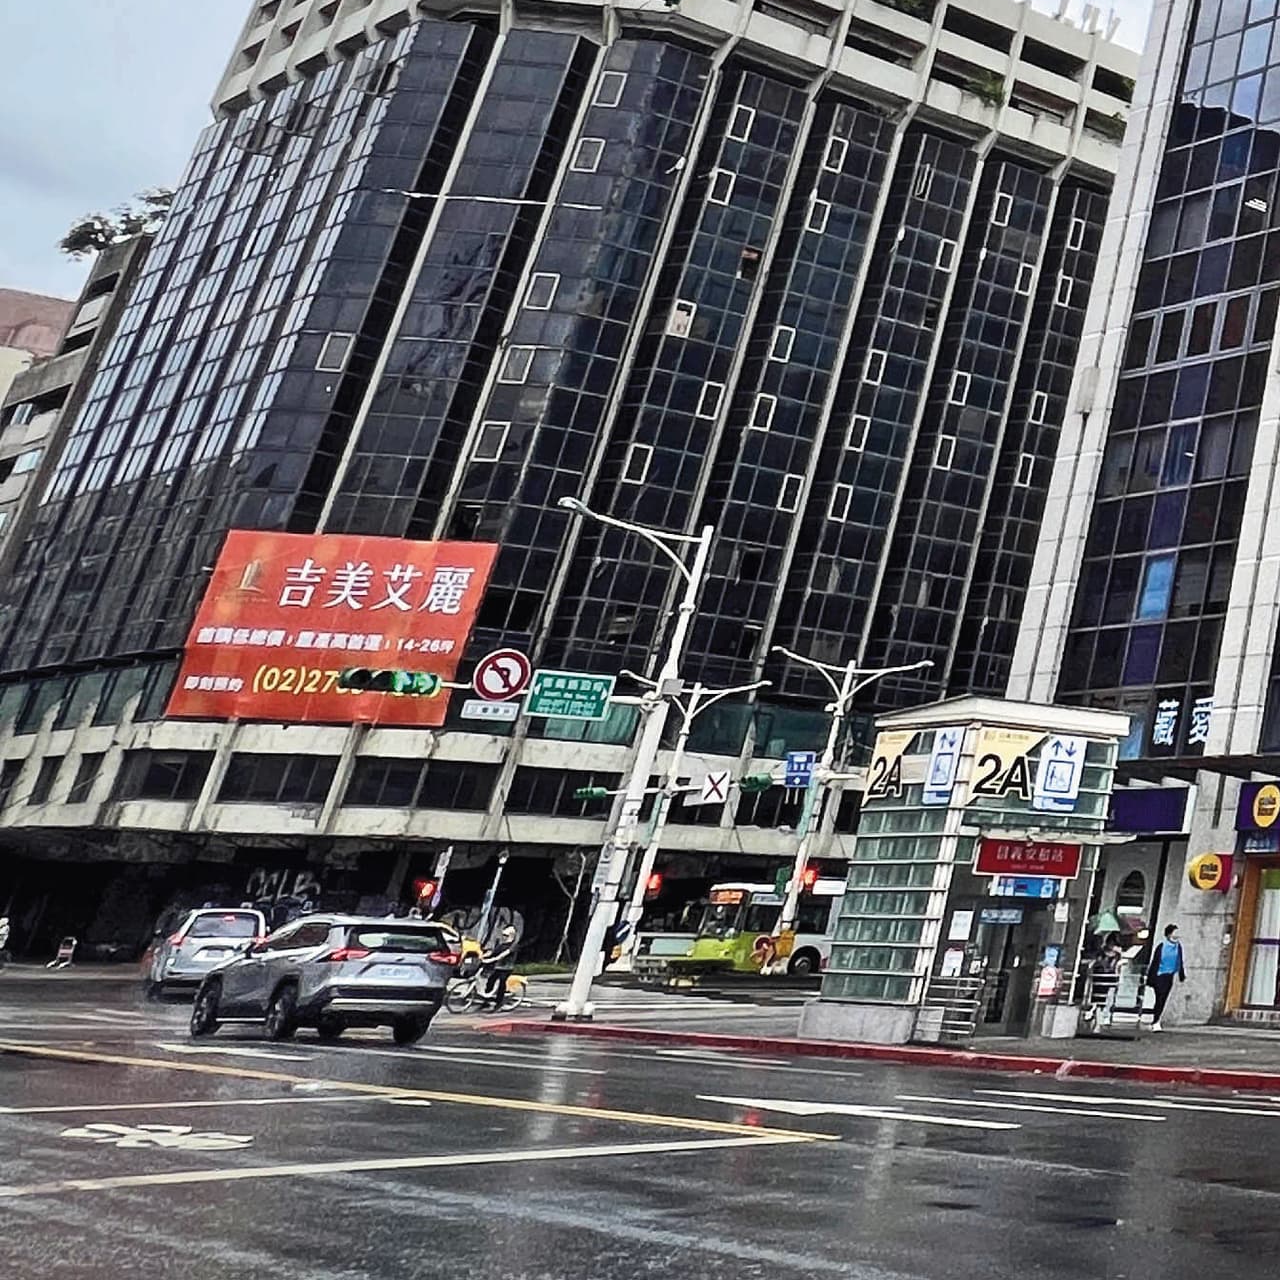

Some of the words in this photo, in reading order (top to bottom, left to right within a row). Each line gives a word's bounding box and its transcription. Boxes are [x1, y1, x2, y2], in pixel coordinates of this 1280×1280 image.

[278, 558, 475, 615] 吉美艾麗
[868, 754, 902, 797] 2A
[972, 753, 1030, 799] 2A
